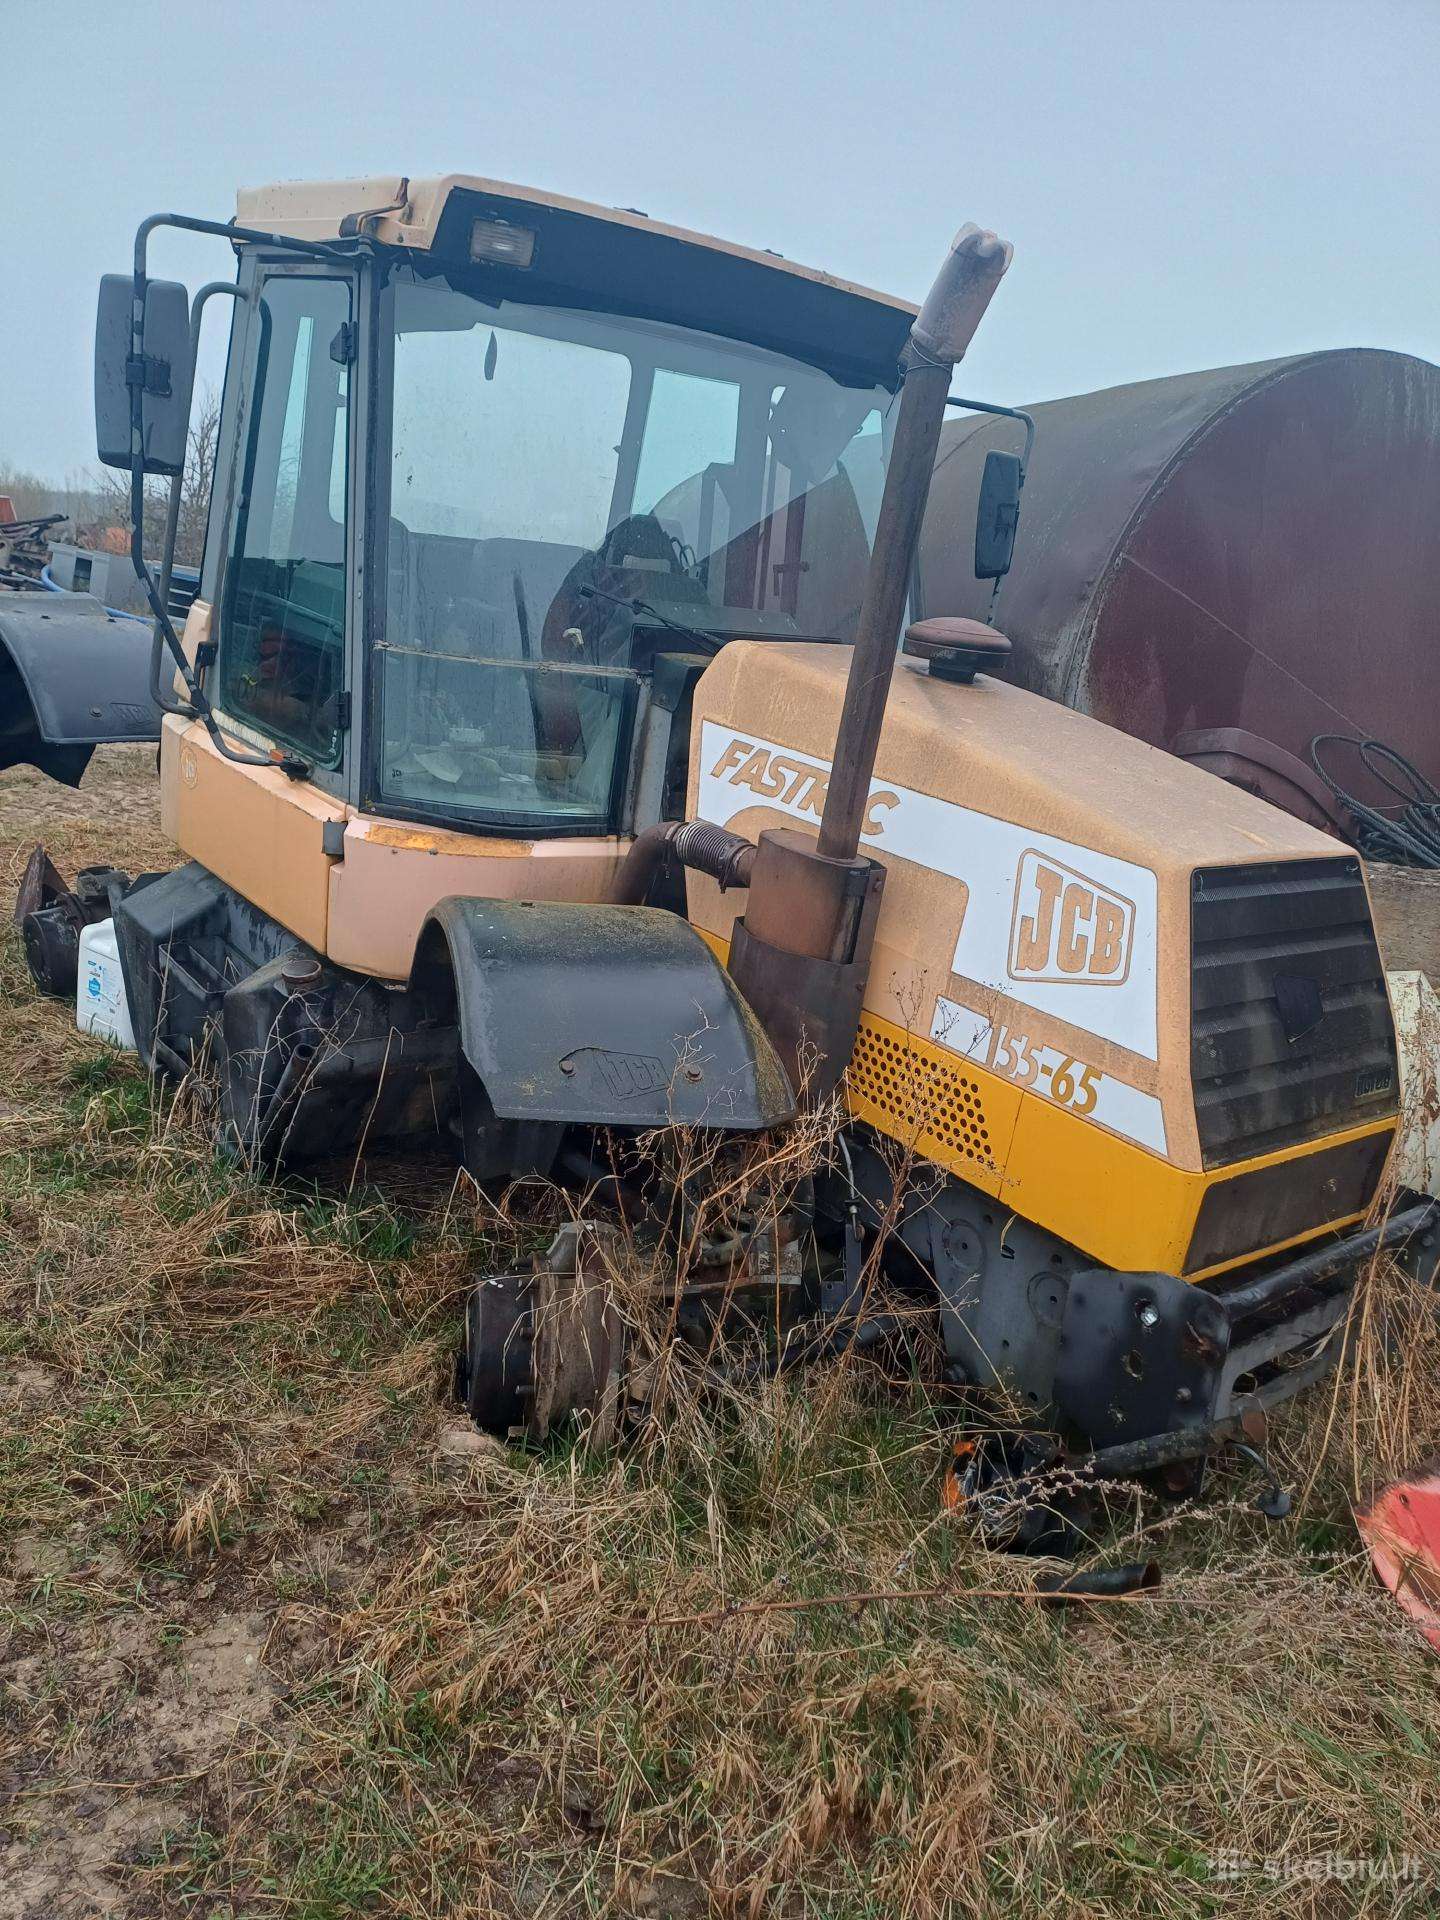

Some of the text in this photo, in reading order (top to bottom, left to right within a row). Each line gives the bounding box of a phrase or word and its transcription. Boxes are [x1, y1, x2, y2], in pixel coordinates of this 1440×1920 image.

[711, 739, 901, 836] FASTRC
[1015, 863, 1125, 975] JCB
[985, 1025, 1103, 1115] 155-65
